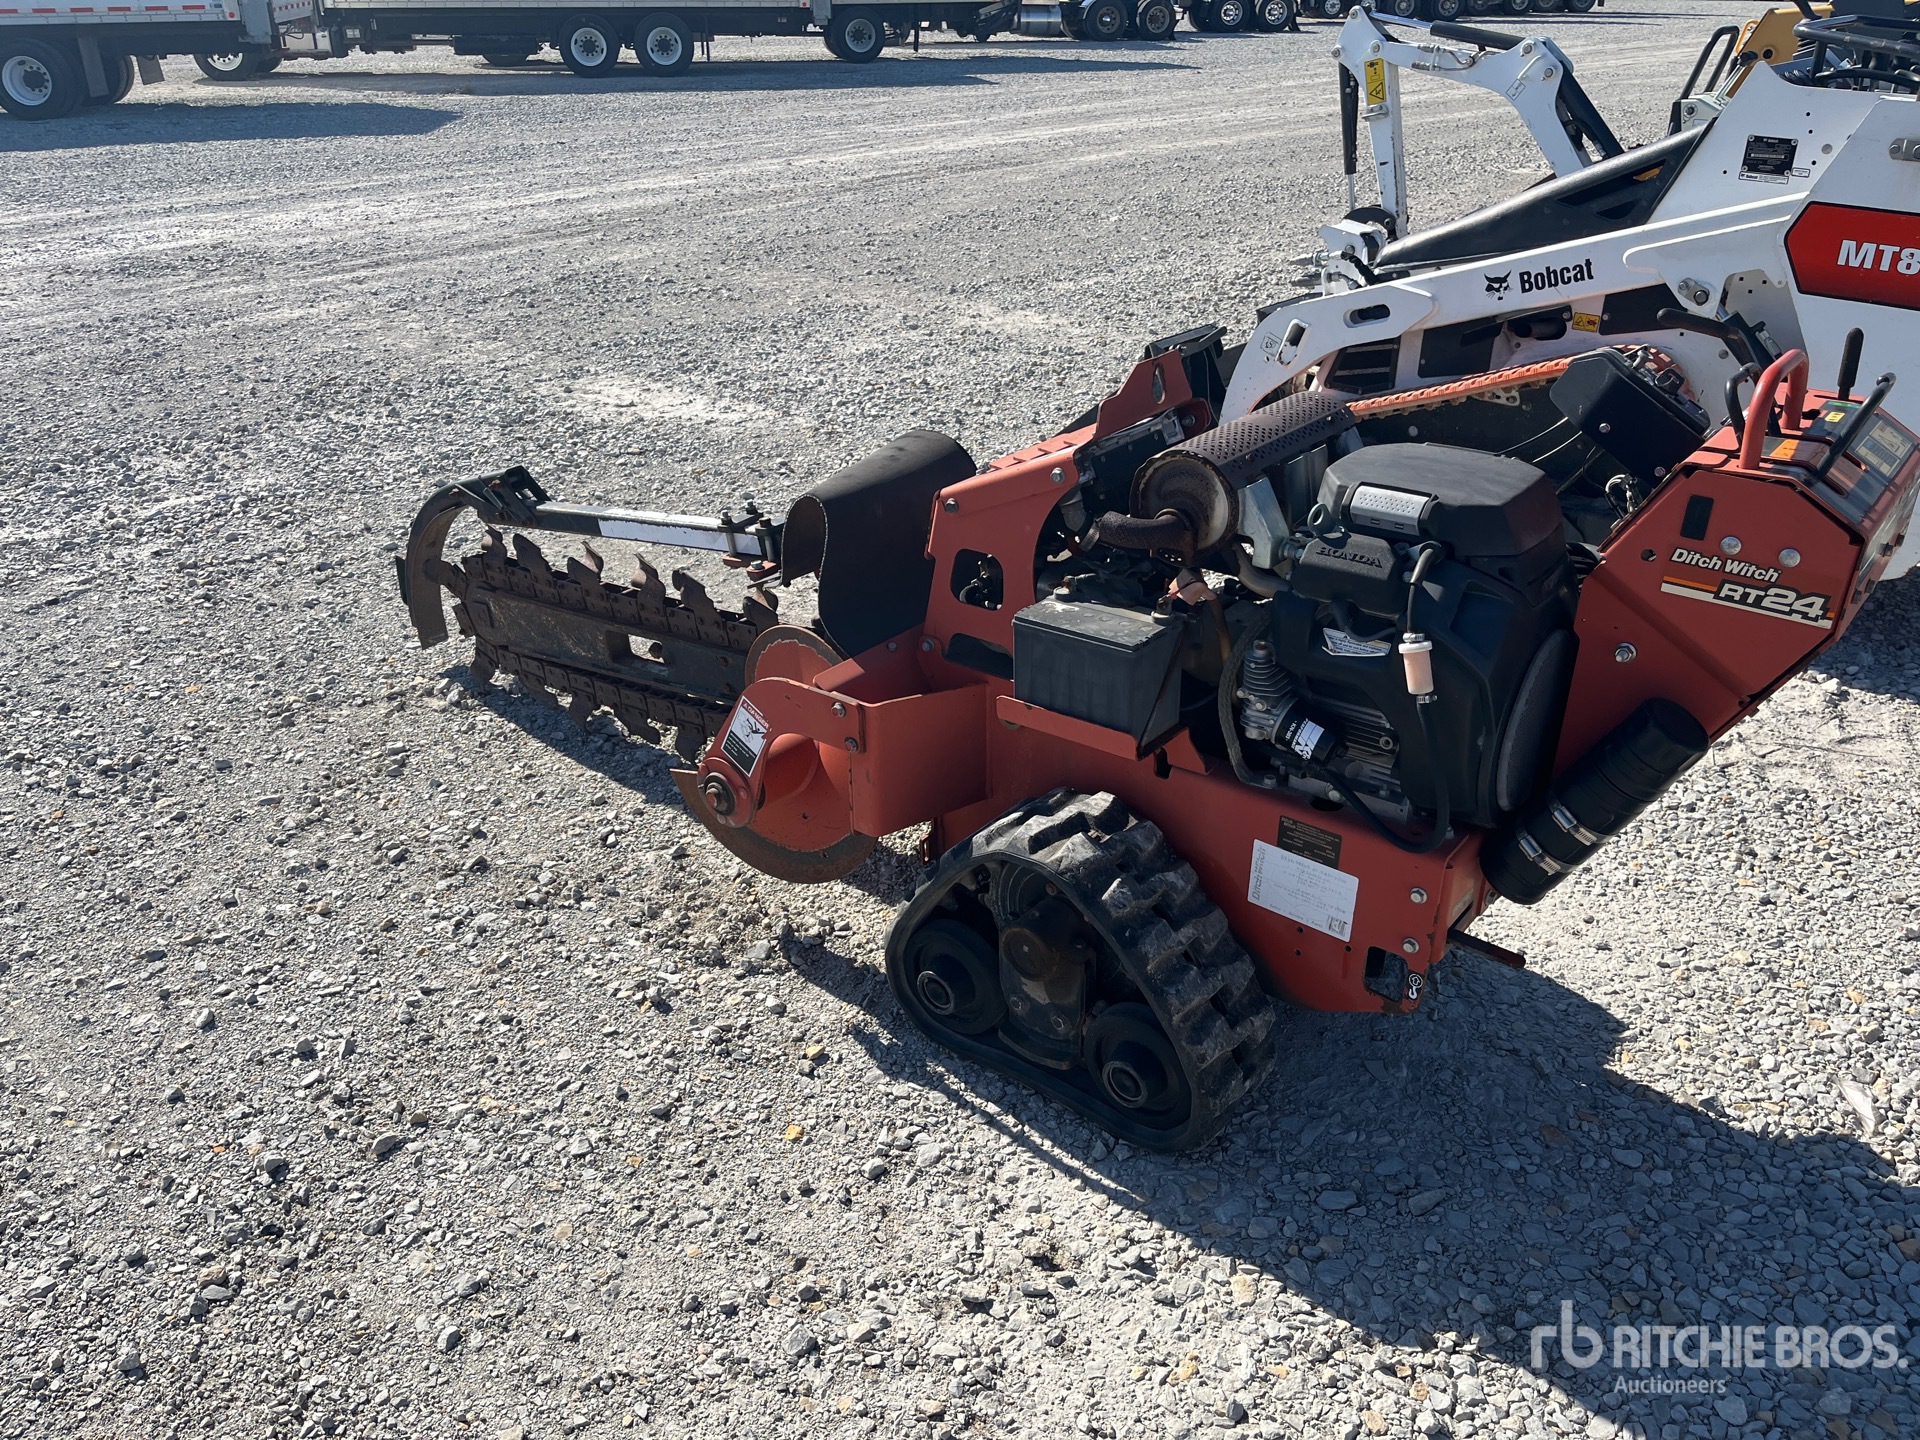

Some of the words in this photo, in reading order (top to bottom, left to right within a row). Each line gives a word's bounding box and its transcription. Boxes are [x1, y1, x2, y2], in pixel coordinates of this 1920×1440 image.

[1837, 239, 1920, 275] MT8
[1519, 258, 1594, 294] Bobcat
[1316, 546, 1383, 569] HONDA
[1671, 548, 1722, 570] Ditch
[1724, 559, 1780, 583] Witch
[1718, 583, 1825, 618] RT24
[747, 705, 769, 728] DANGER
